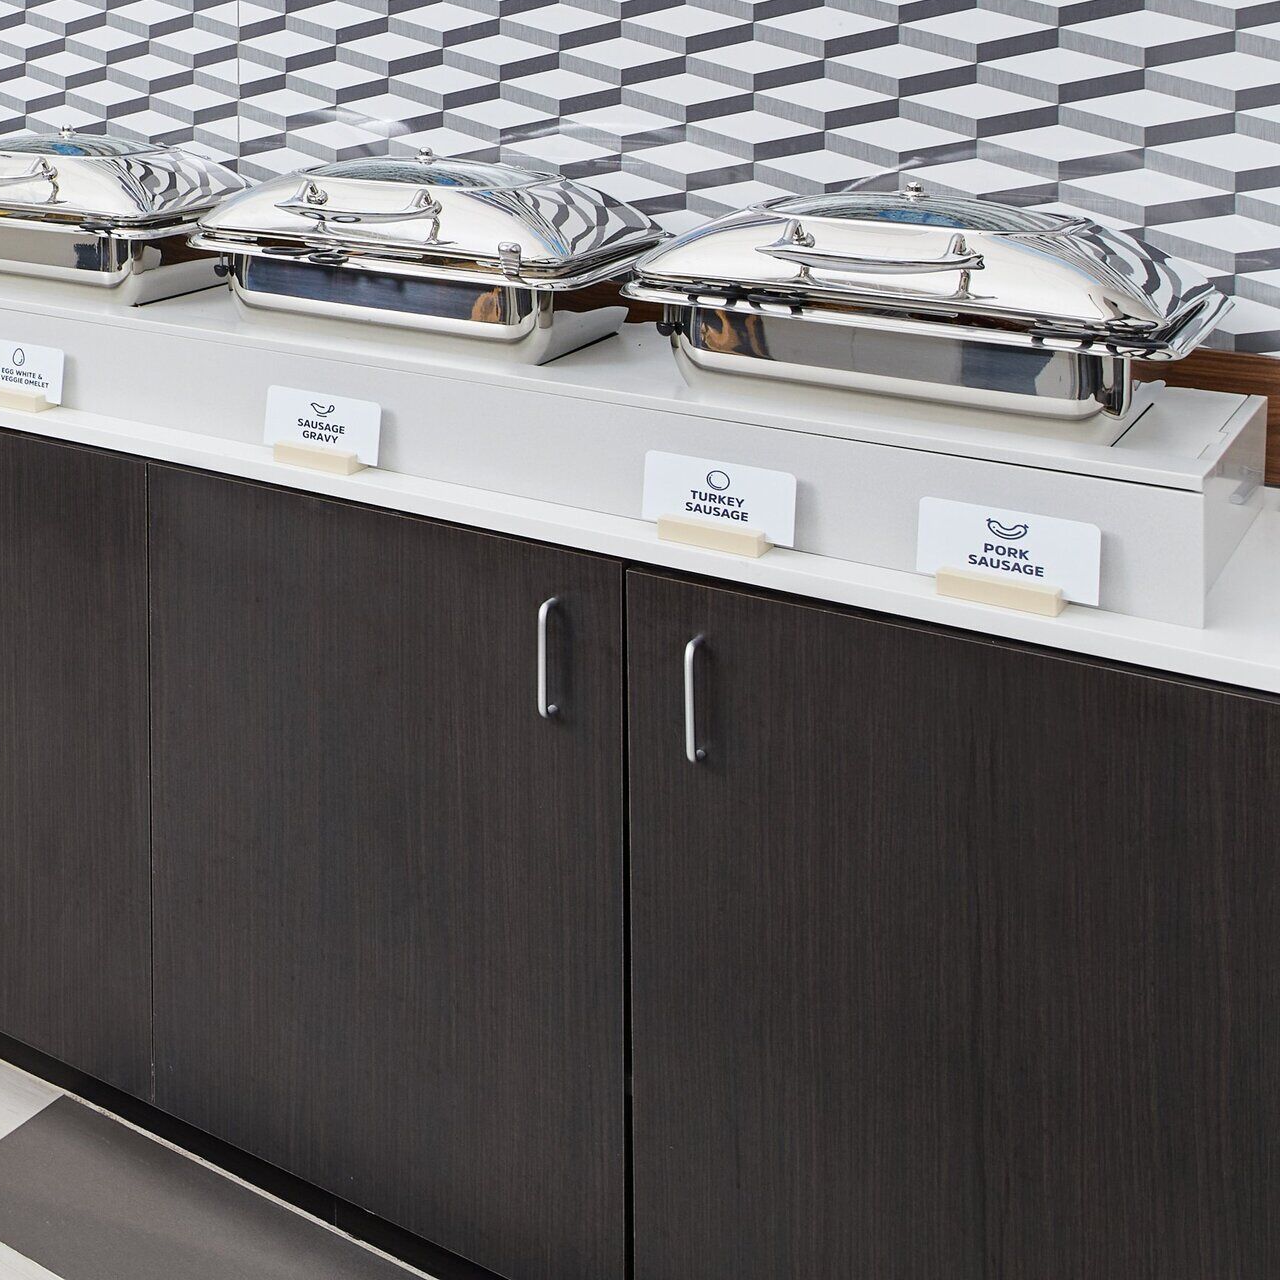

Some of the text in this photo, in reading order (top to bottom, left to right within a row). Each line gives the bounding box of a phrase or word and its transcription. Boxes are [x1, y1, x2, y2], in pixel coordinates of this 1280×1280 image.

[0, 374, 23, 385] VEGGIE
[24, 378, 49, 389] OMELET
[1, 367, 14, 375] EGG
[15, 369, 37, 379] WHITE
[297, 418, 345, 434] SAUSAGE
[302, 430, 338, 444] GRAVY
[690, 489, 745, 508] TURKEY
[685, 501, 749, 522] SAUSAGE
[983, 542, 1030, 561] PORK
[968, 553, 1045, 578] SAUSAGE
